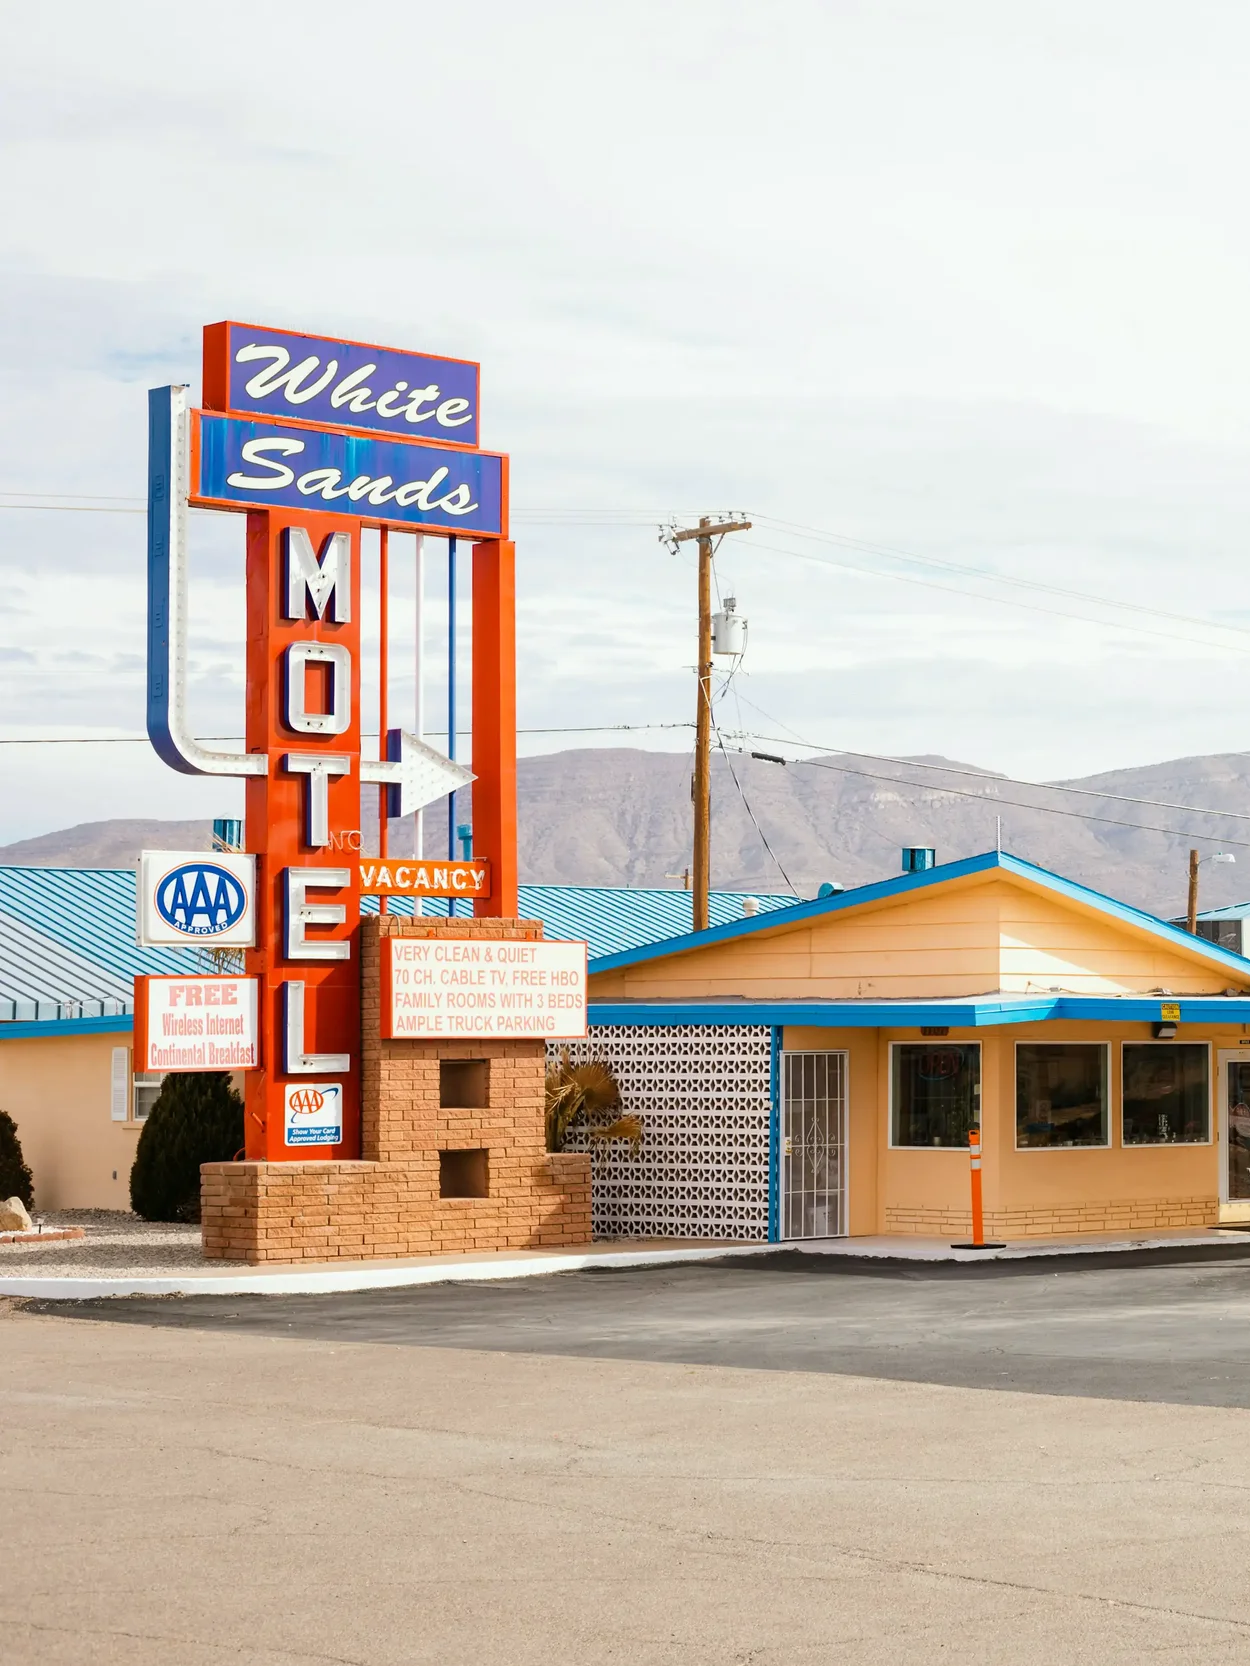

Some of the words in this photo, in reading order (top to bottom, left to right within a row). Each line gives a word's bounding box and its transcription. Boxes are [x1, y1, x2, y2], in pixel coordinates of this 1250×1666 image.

[235, 343, 473, 428] White
[226, 436, 480, 516] Sands
[284, 526, 351, 1074] MOTEL
[359, 865, 486, 891] VACANCY
[169, 868, 233, 928] AAA
[174, 921, 228, 935] APPROVED
[394, 945, 431, 962] VERY
[434, 946, 480, 963] CLEAN
[484, 947, 493, 963] &
[497, 947, 537, 964] QUIET
[394, 968, 409, 985] 70
[440, 969, 485, 985] CABLE
[512, 970, 547, 986] FREE
[551, 971, 579, 986] HBO
[169, 983, 238, 1007] FREE
[395, 992, 443, 1009] FAMILY
[447, 992, 496, 1009] ROOMS
[500, 993, 533, 1009] WITH
[536, 993, 544, 1009] 3
[548, 993, 583, 1009] BEDS
[162, 1012, 203, 1036] Wireless
[206, 1012, 244, 1036] Internet
[396, 1015, 443, 1031] AMPLE
[447, 1015, 493, 1031] TRUCK
[497, 1015, 555, 1031] PARKING
[151, 1042, 206, 1067] Continental
[208, 1041, 255, 1065] Breakfast
[293, 1089, 321, 1114] AAA
[317, 1134, 339, 1142] Lodging
